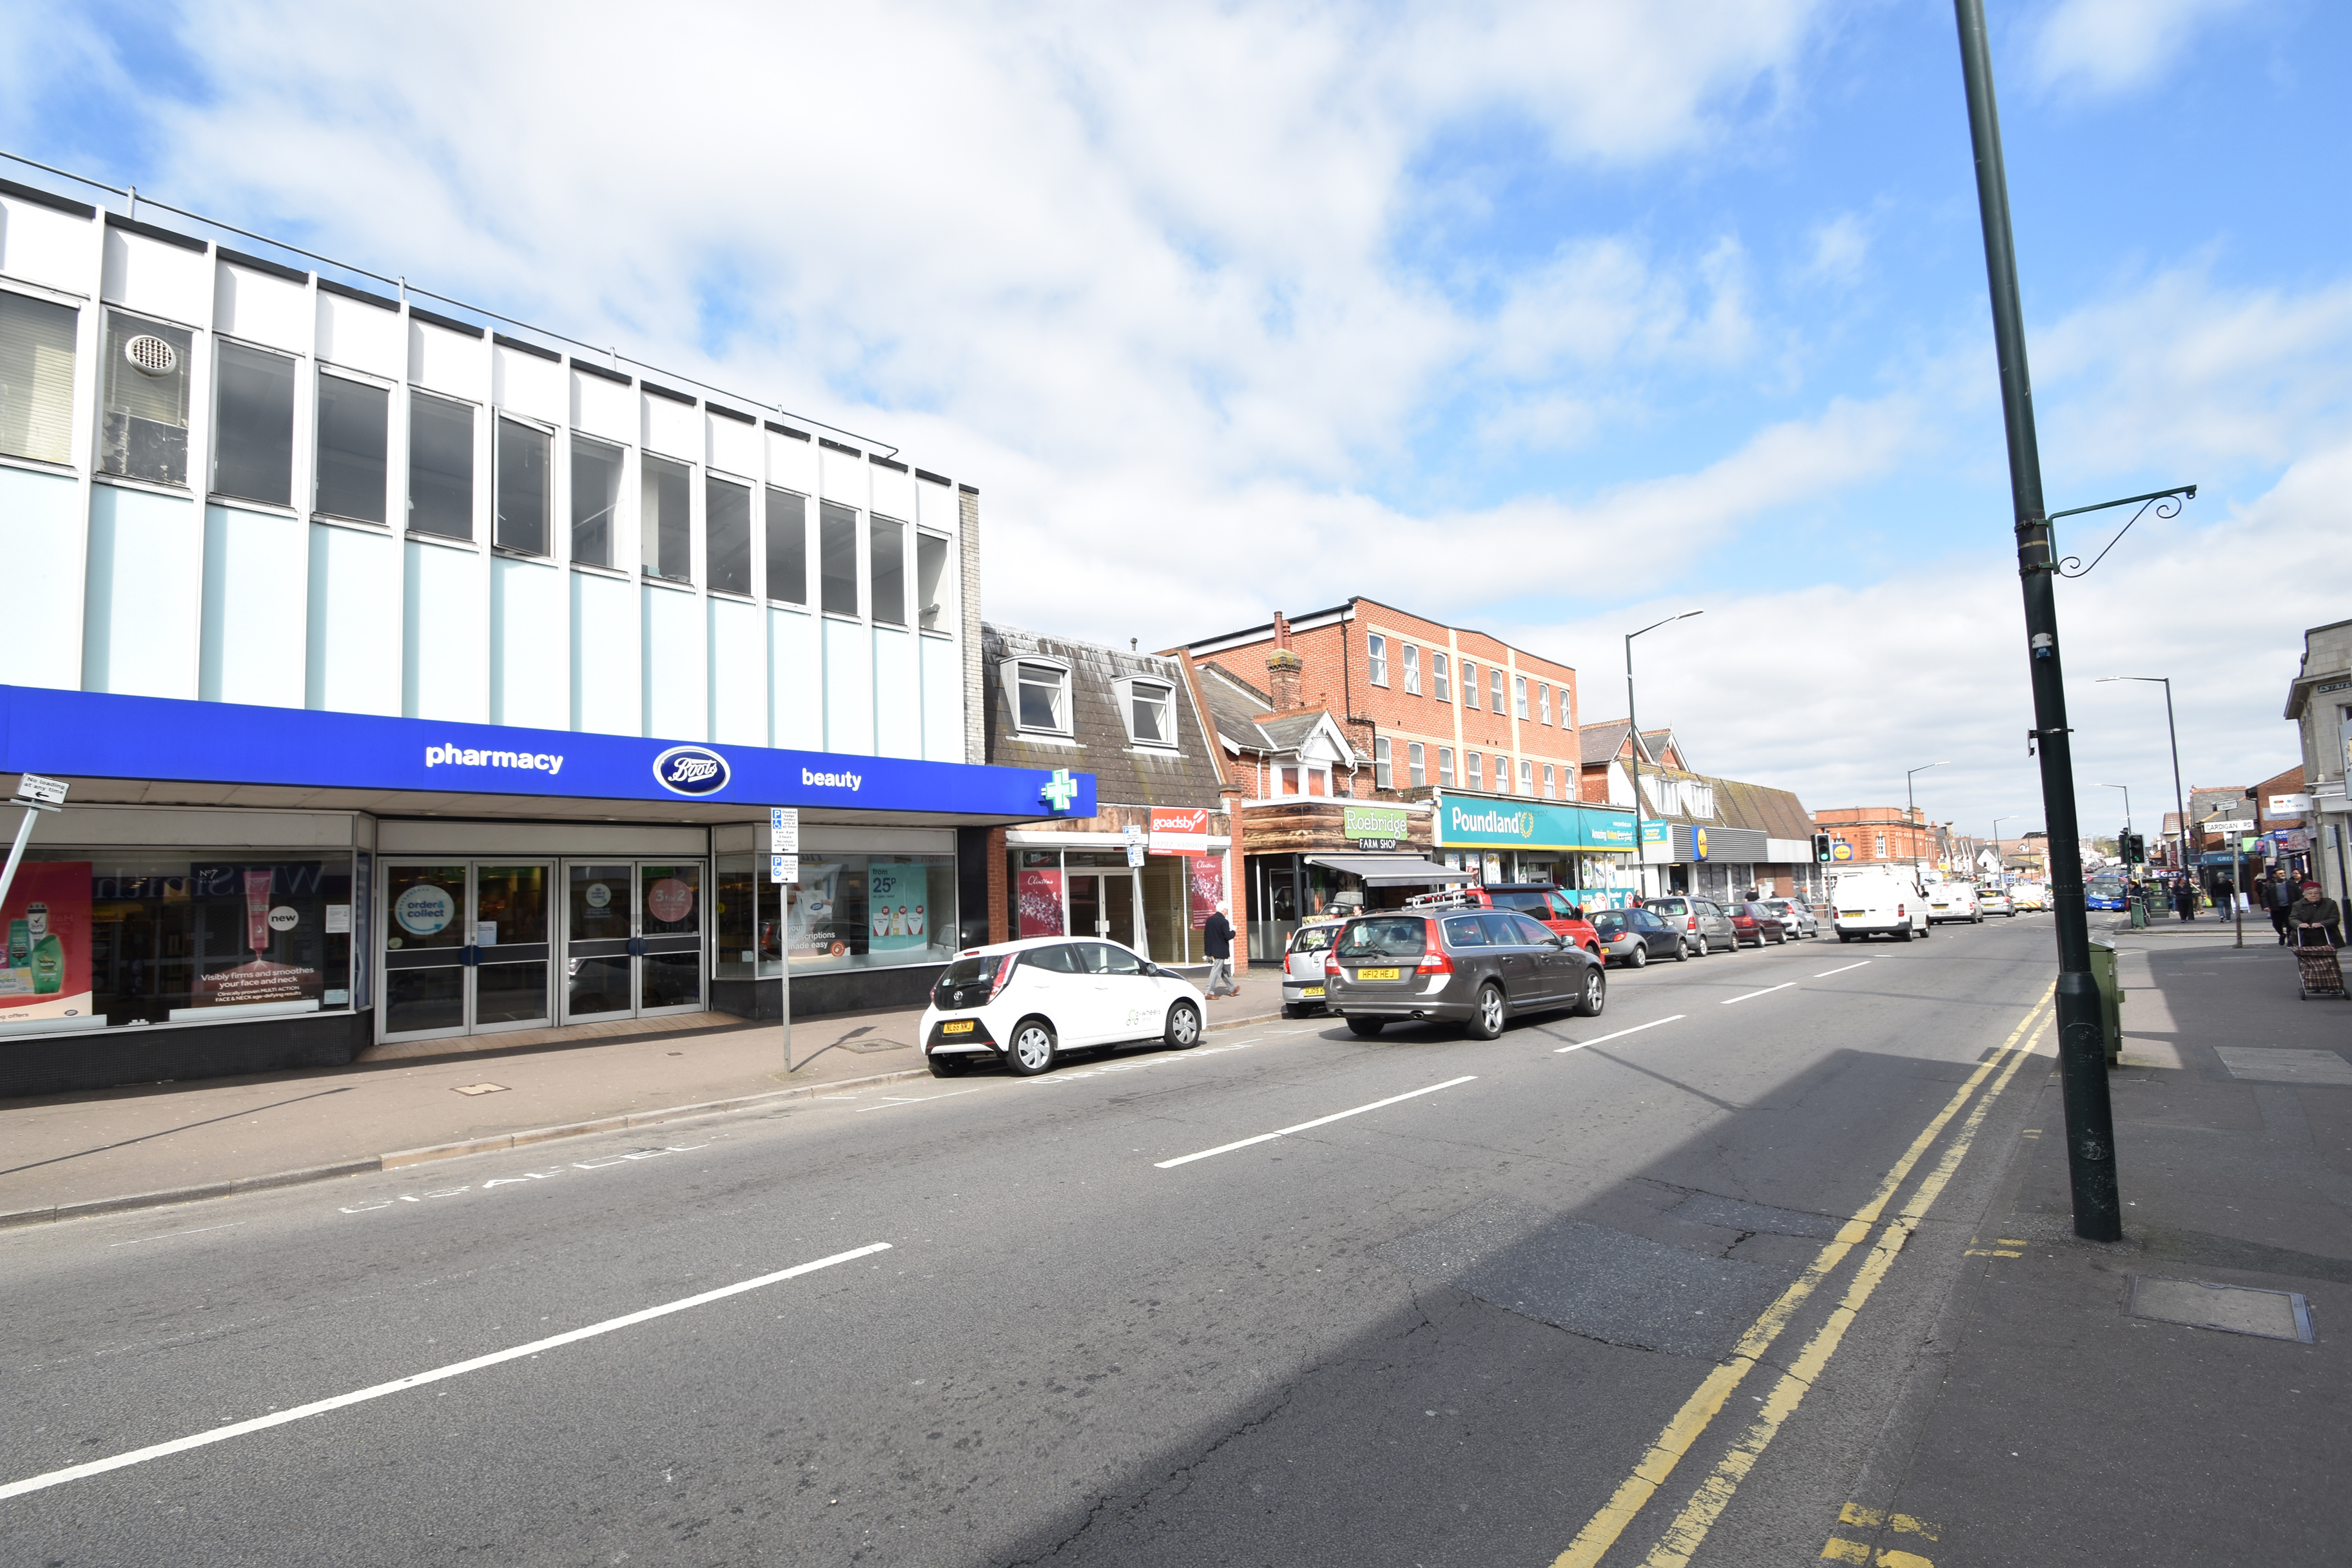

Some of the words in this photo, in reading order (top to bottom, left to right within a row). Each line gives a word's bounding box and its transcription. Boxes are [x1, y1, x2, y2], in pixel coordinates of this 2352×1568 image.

[2318, 681, 2351, 692] ESTATE
[426, 742, 563, 775] pharmacy
[668, 757, 717, 782] Boots
[39, 780, 65, 790] loading
[802, 768, 861, 791] beauty
[1152, 816, 1196, 831] goadsby
[1345, 810, 1406, 839] Roebridge
[1452, 806, 1519, 834] Poundland
[1359, 839, 1378, 849] FARM
[1380, 839, 1395, 849] SHOP
[1196, 860, 1216, 869] Clintons
[1027, 875, 1053, 886] Clintons
[656, 889, 664, 902] 3
[677, 889, 686, 902] 2
[407, 909, 445, 918] collect
[788, 931, 835, 940] prescriptions
[201, 972, 229, 982] Visibly
[231, 971, 253, 980] firms
[273, 967, 315, 976] smoothes
[219, 981, 238, 989] your
[1100, 1057, 1185, 1072] CLUB
